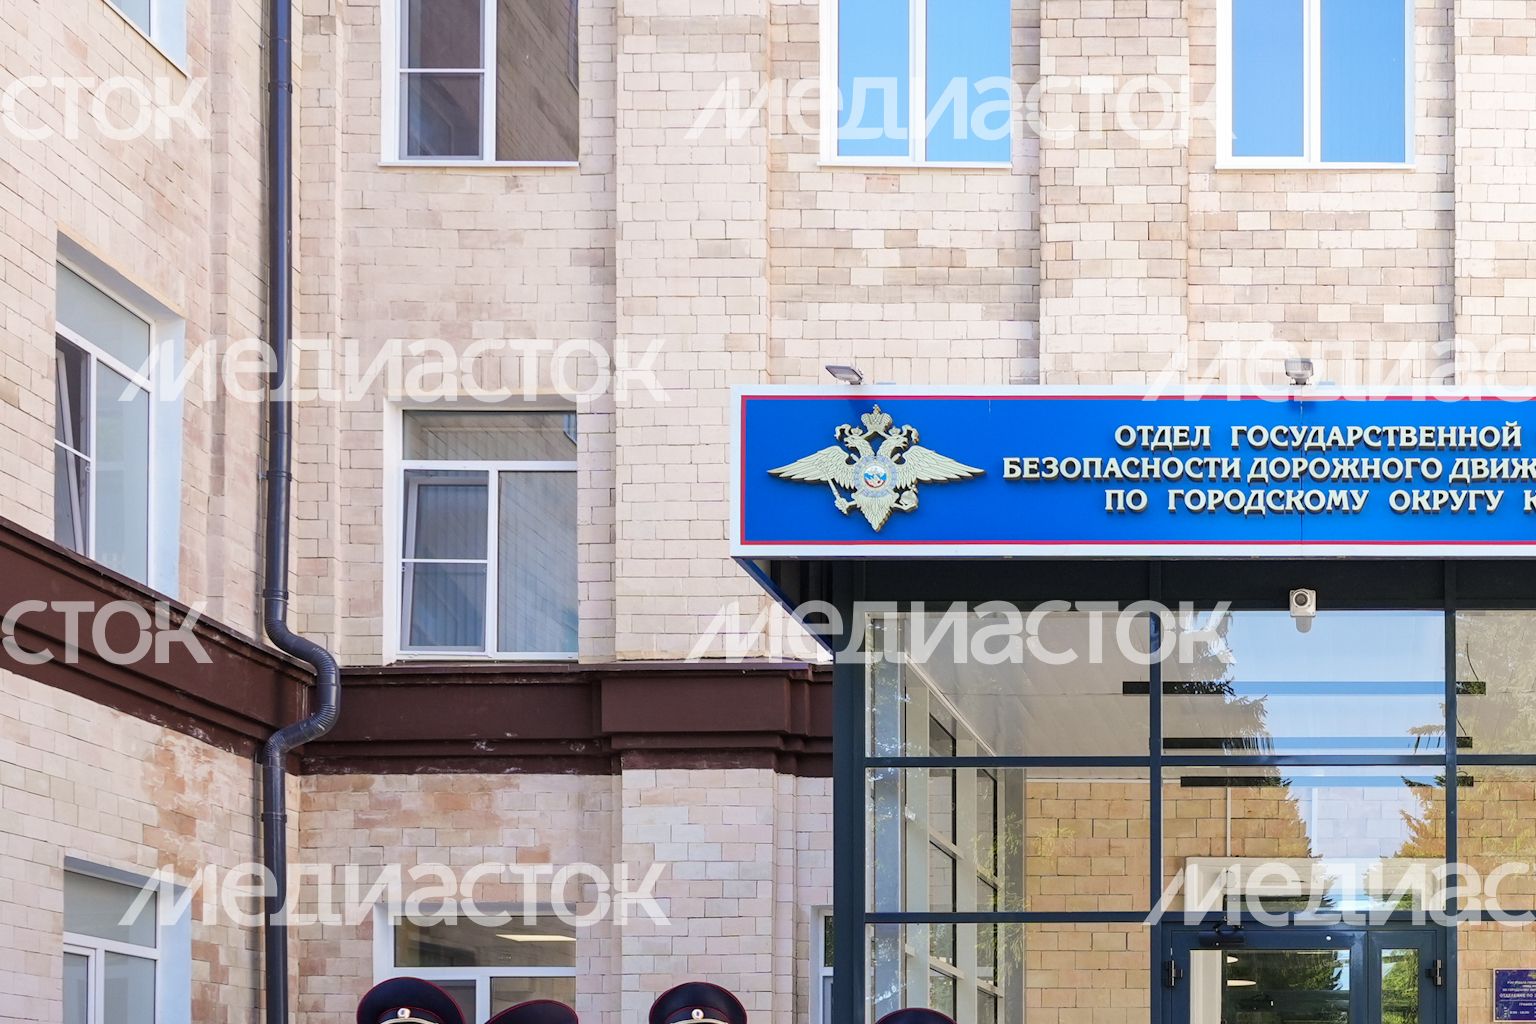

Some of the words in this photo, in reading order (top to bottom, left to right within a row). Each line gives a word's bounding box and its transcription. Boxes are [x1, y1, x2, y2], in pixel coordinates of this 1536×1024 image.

[1114, 425, 1211, 452] ОТДЕЛ
[1230, 420, 1522, 453] ГОСУДАРСТВЕННОЙ
[1002, 457, 1241, 481] БЕЗОПАСНОСТИ
[1246, 457, 1443, 484] ДОРОЖНОГО
[1104, 489, 1148, 513] ПО
[1167, 489, 1369, 516] ГОРОДСКОМУ
[1388, 489, 1504, 513] ОКРУГУ
